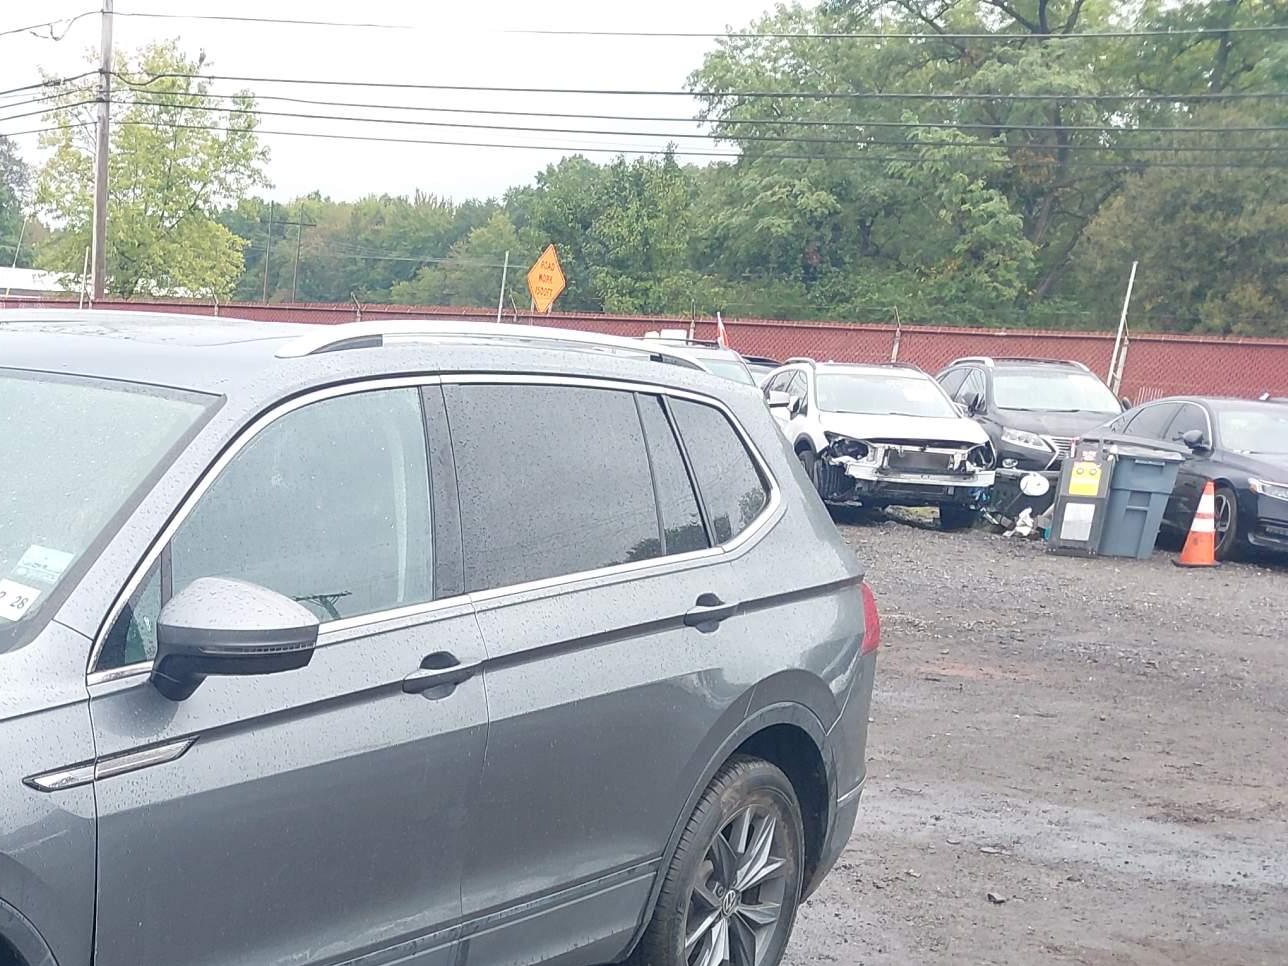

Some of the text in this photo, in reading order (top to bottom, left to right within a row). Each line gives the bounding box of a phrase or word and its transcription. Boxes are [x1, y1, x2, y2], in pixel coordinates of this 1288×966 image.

[541, 260, 556, 272] ROAD
[538, 273, 553, 285] WORK
[9, 595, 29, 610] 28
